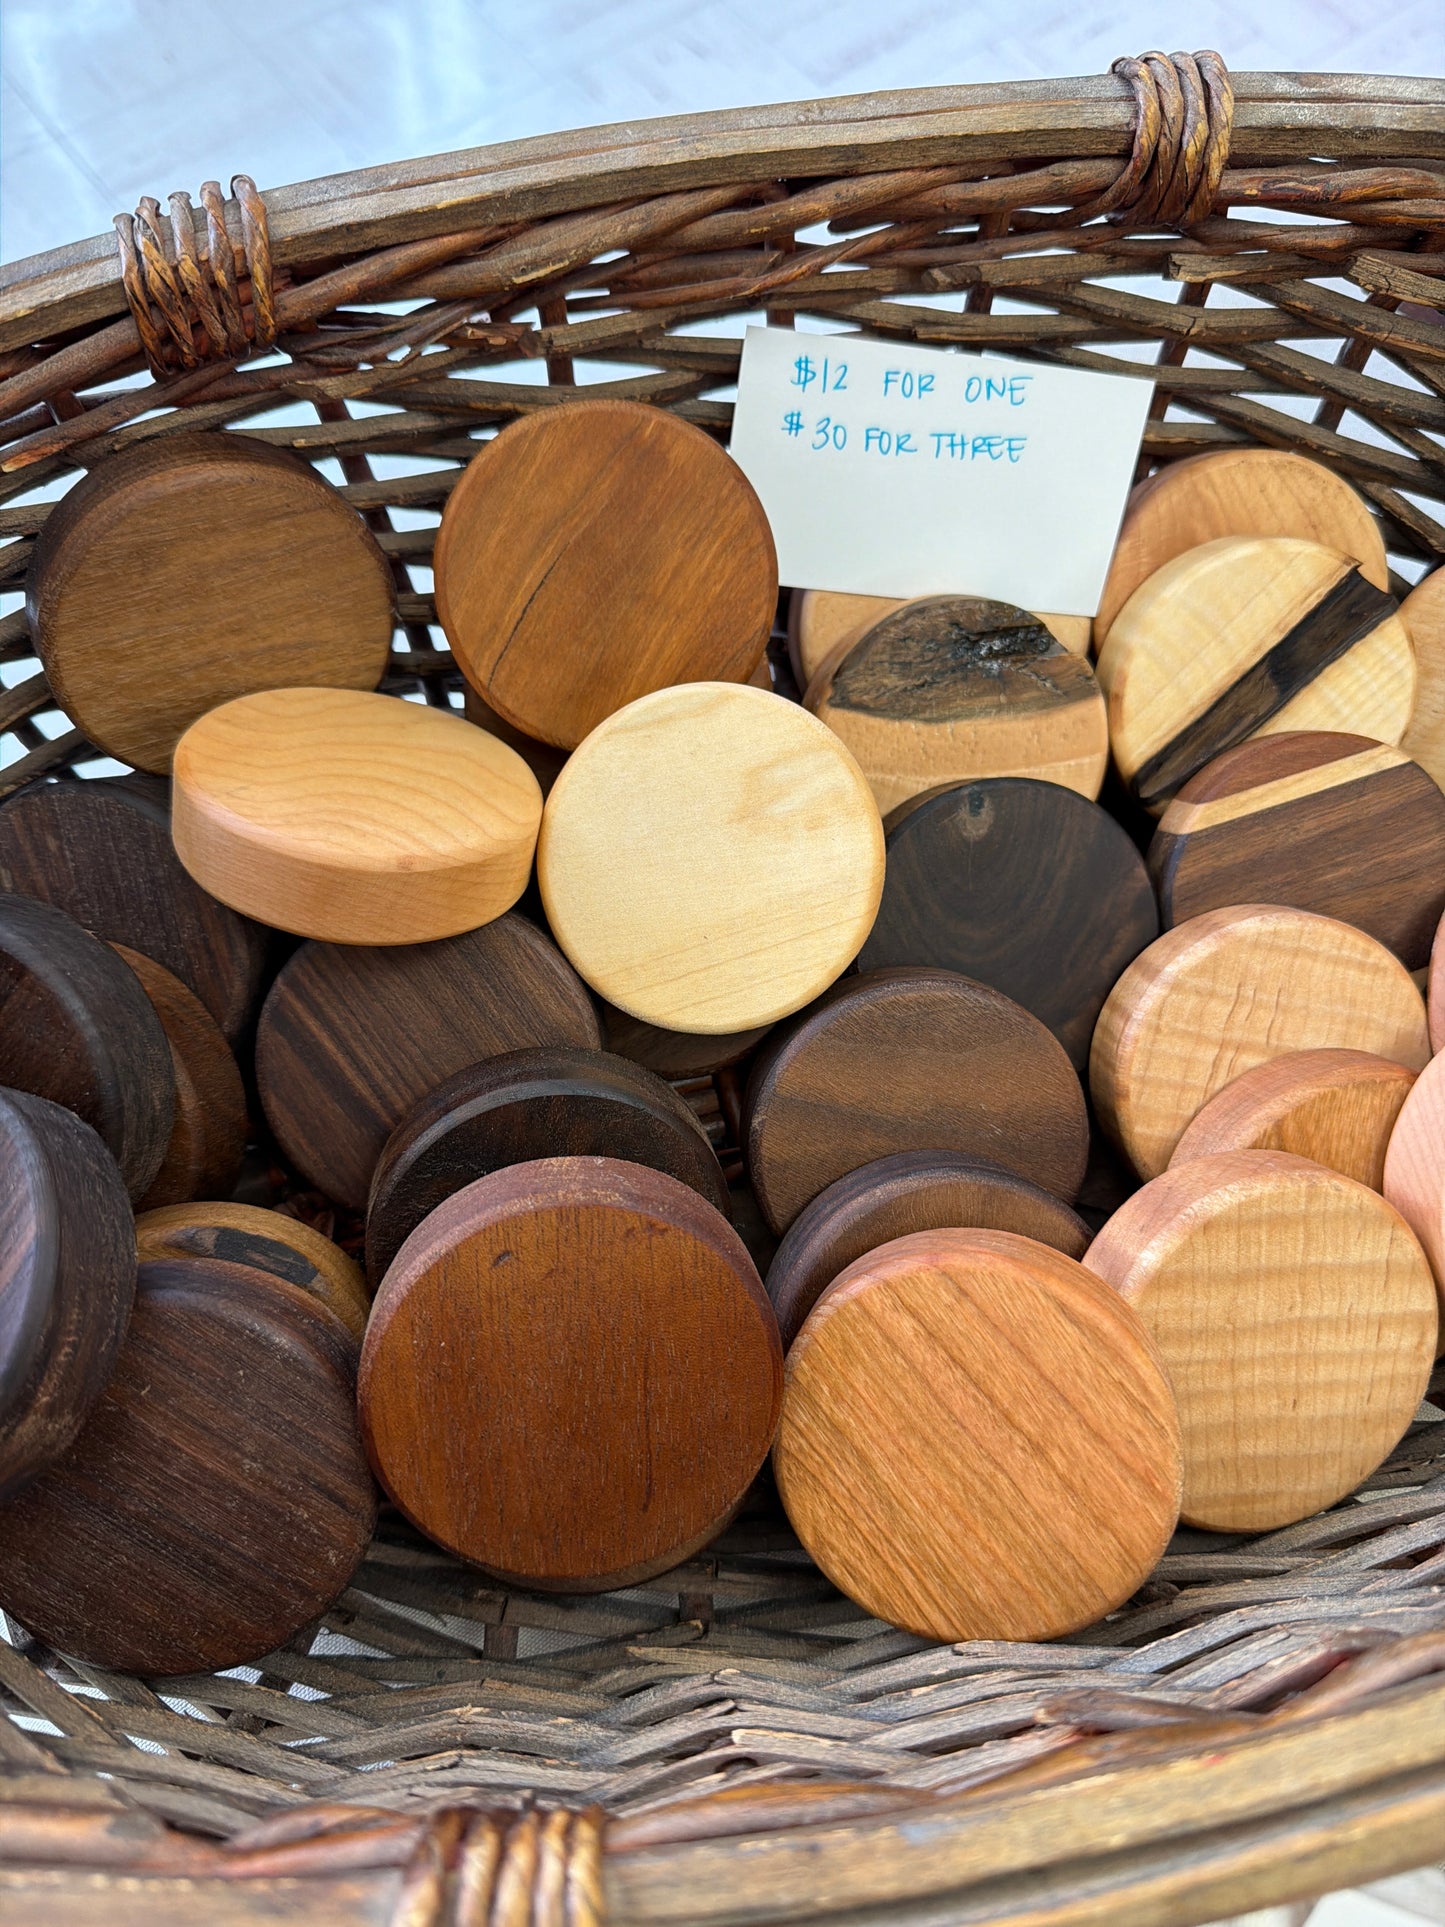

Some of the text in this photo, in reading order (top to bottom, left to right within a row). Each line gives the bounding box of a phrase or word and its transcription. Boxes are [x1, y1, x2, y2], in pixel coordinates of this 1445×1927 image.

[790, 355, 1034, 406] $12 FOR ONE
[864, 427, 917, 456] FOR
[929, 432, 1027, 463] THREE
